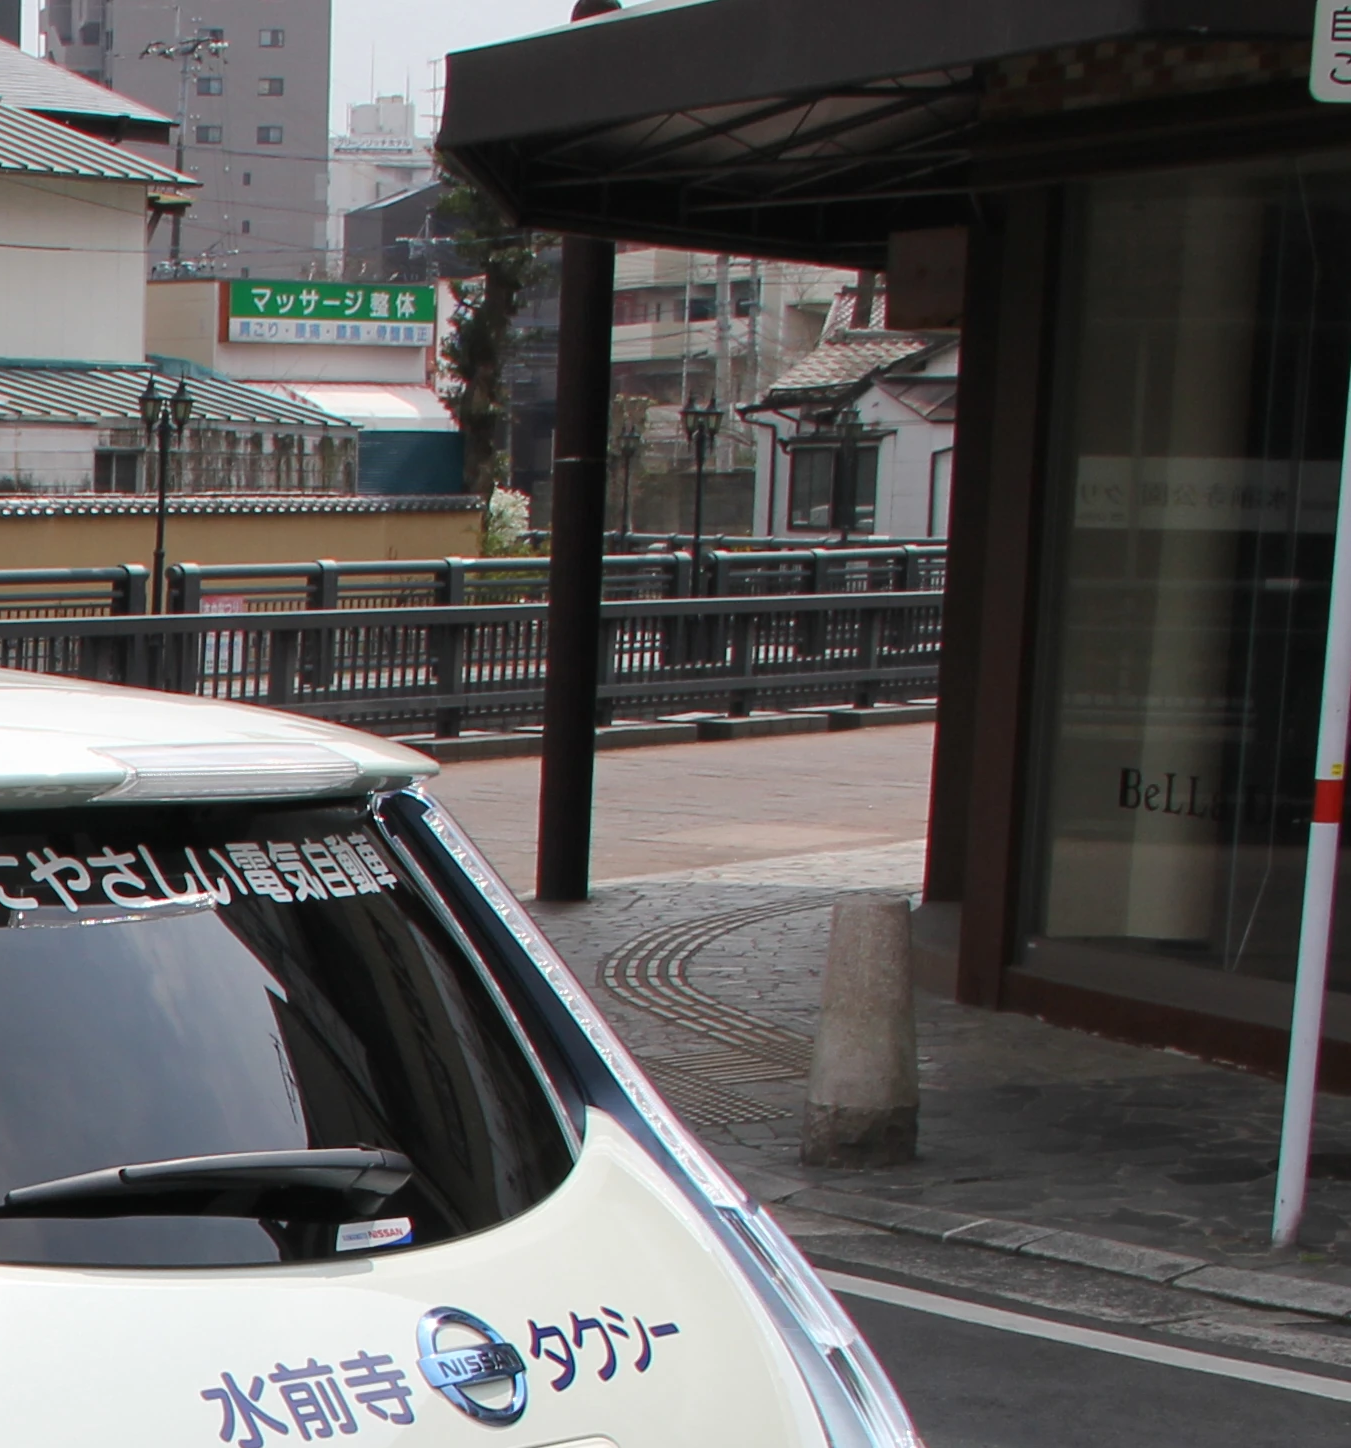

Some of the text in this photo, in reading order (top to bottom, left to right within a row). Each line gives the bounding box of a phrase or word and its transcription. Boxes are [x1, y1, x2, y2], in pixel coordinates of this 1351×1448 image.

[250, 287, 417, 319] マッサージ整体
[436, 1345, 527, 1382] NISSAN
[527, 1305, 682, 1393] タクシー
